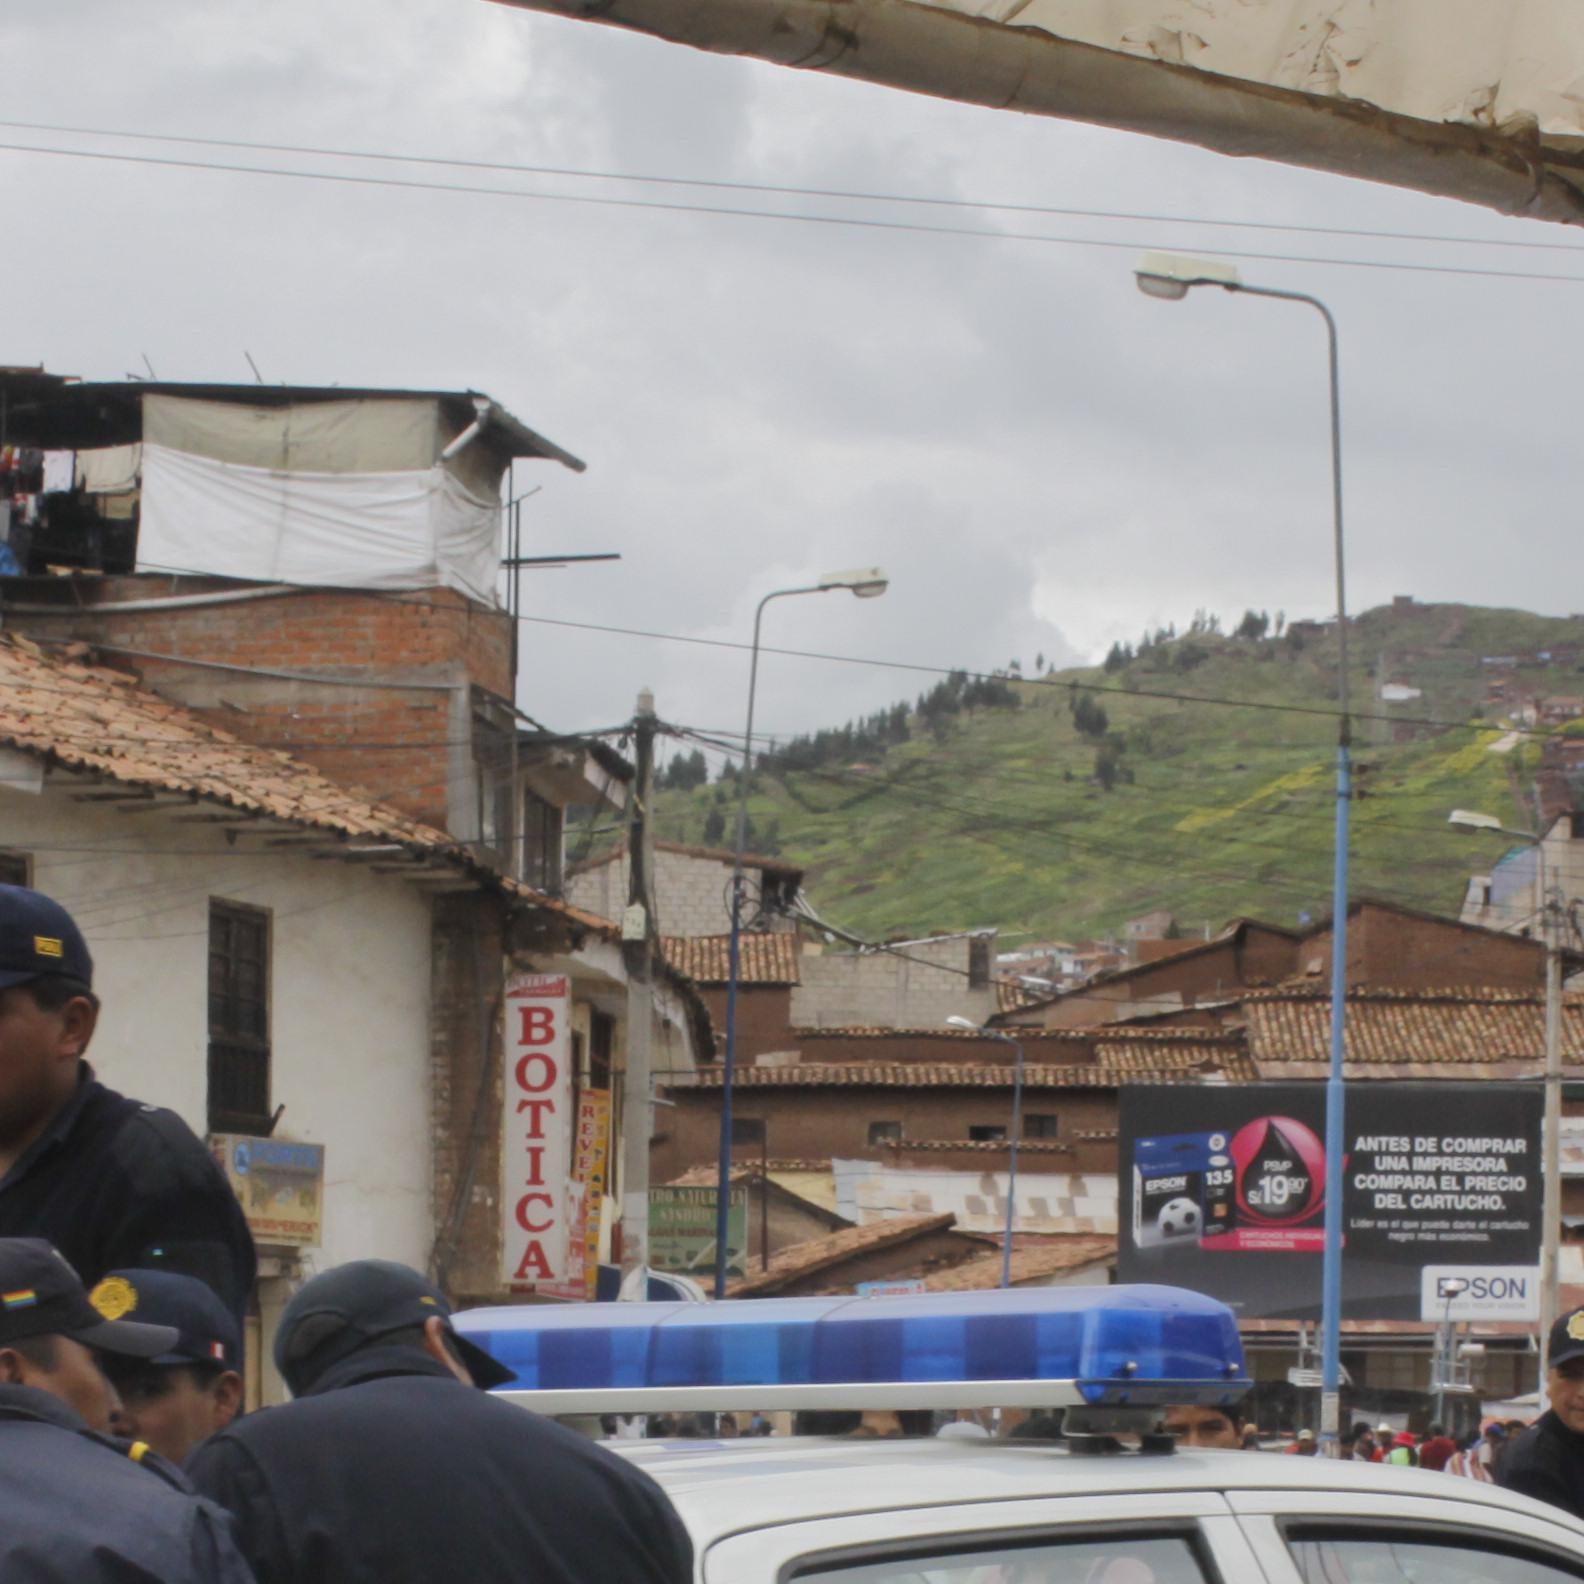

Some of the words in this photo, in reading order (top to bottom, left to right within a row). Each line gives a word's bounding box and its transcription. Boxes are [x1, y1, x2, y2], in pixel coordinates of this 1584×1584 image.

[513, 1006, 557, 1279] BOTICA
[1354, 1136, 1410, 1152] ANTES
[1414, 1137, 1438, 1152] DE
[1441, 1138, 1527, 1154] COMPRAR
[1374, 1156, 1410, 1171] UNA
[1412, 1157, 1508, 1173] IMPRESORA
[1145, 1175, 1188, 1192] EPSON
[1354, 1174, 1437, 1190] COMPARA
[1440, 1175, 1461, 1190] EL
[1464, 1176, 1527, 1192] PRECIO
[1374, 1193, 1407, 1209] DEL
[1410, 1194, 1506, 1211] CARTUCHO.
[1437, 1277, 1526, 1299] EPSON
